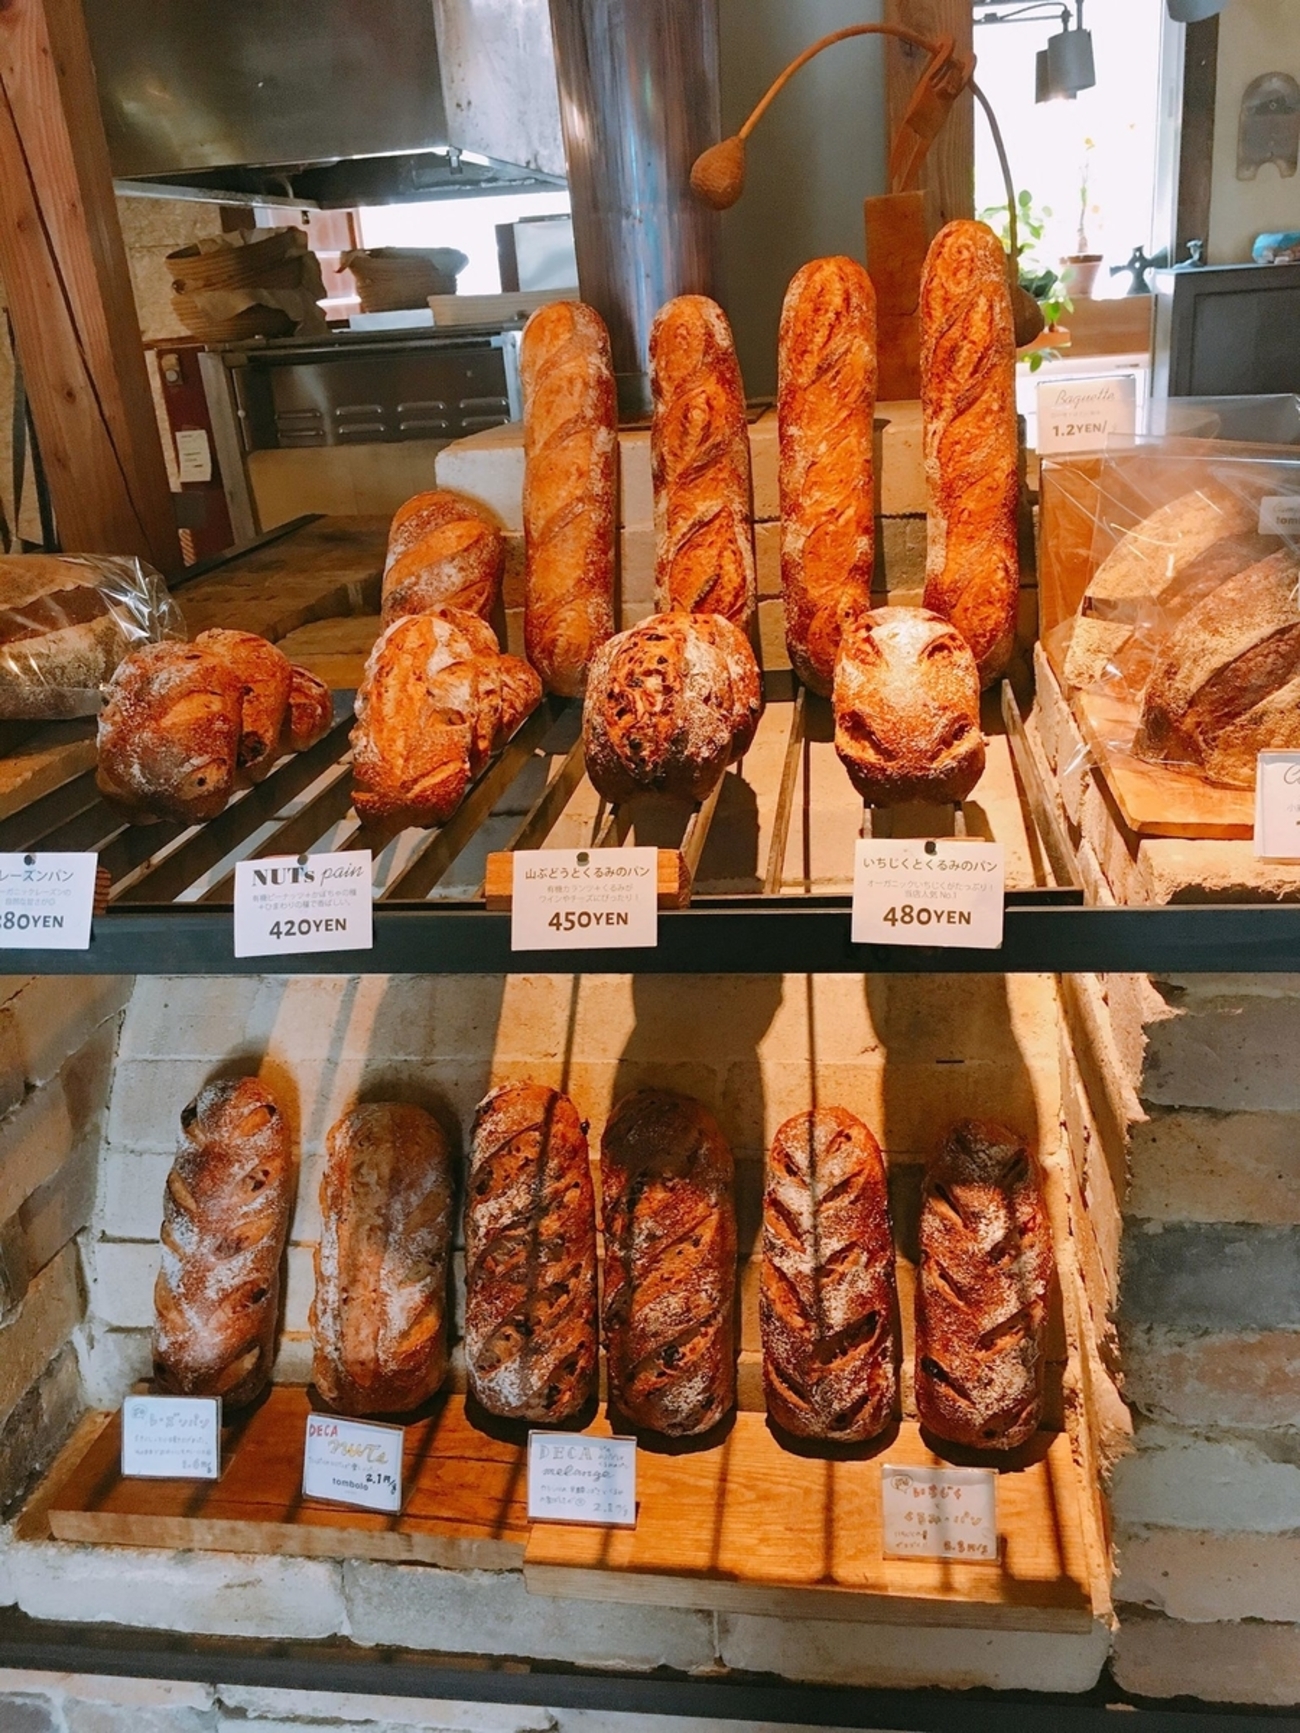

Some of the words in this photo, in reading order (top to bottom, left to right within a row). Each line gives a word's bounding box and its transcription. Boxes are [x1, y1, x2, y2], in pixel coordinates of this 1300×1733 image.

[1054, 387, 1115, 409] Baguette
[525, 866, 650, 880] 山ぶどうとくるみのパン
[863, 858, 997, 872] いちじくとくるみのパン
[320, 863, 364, 887] pain
[0, 911, 64, 930] 80YEN
[548, 911, 628, 931] 450YEN
[883, 904, 971, 927] 480YEN
[269, 918, 347, 939] 420YEN
[309, 1423, 338, 1437] DECA
[539, 1445, 592, 1460] DECA
[332, 1478, 369, 1491] tombolo
